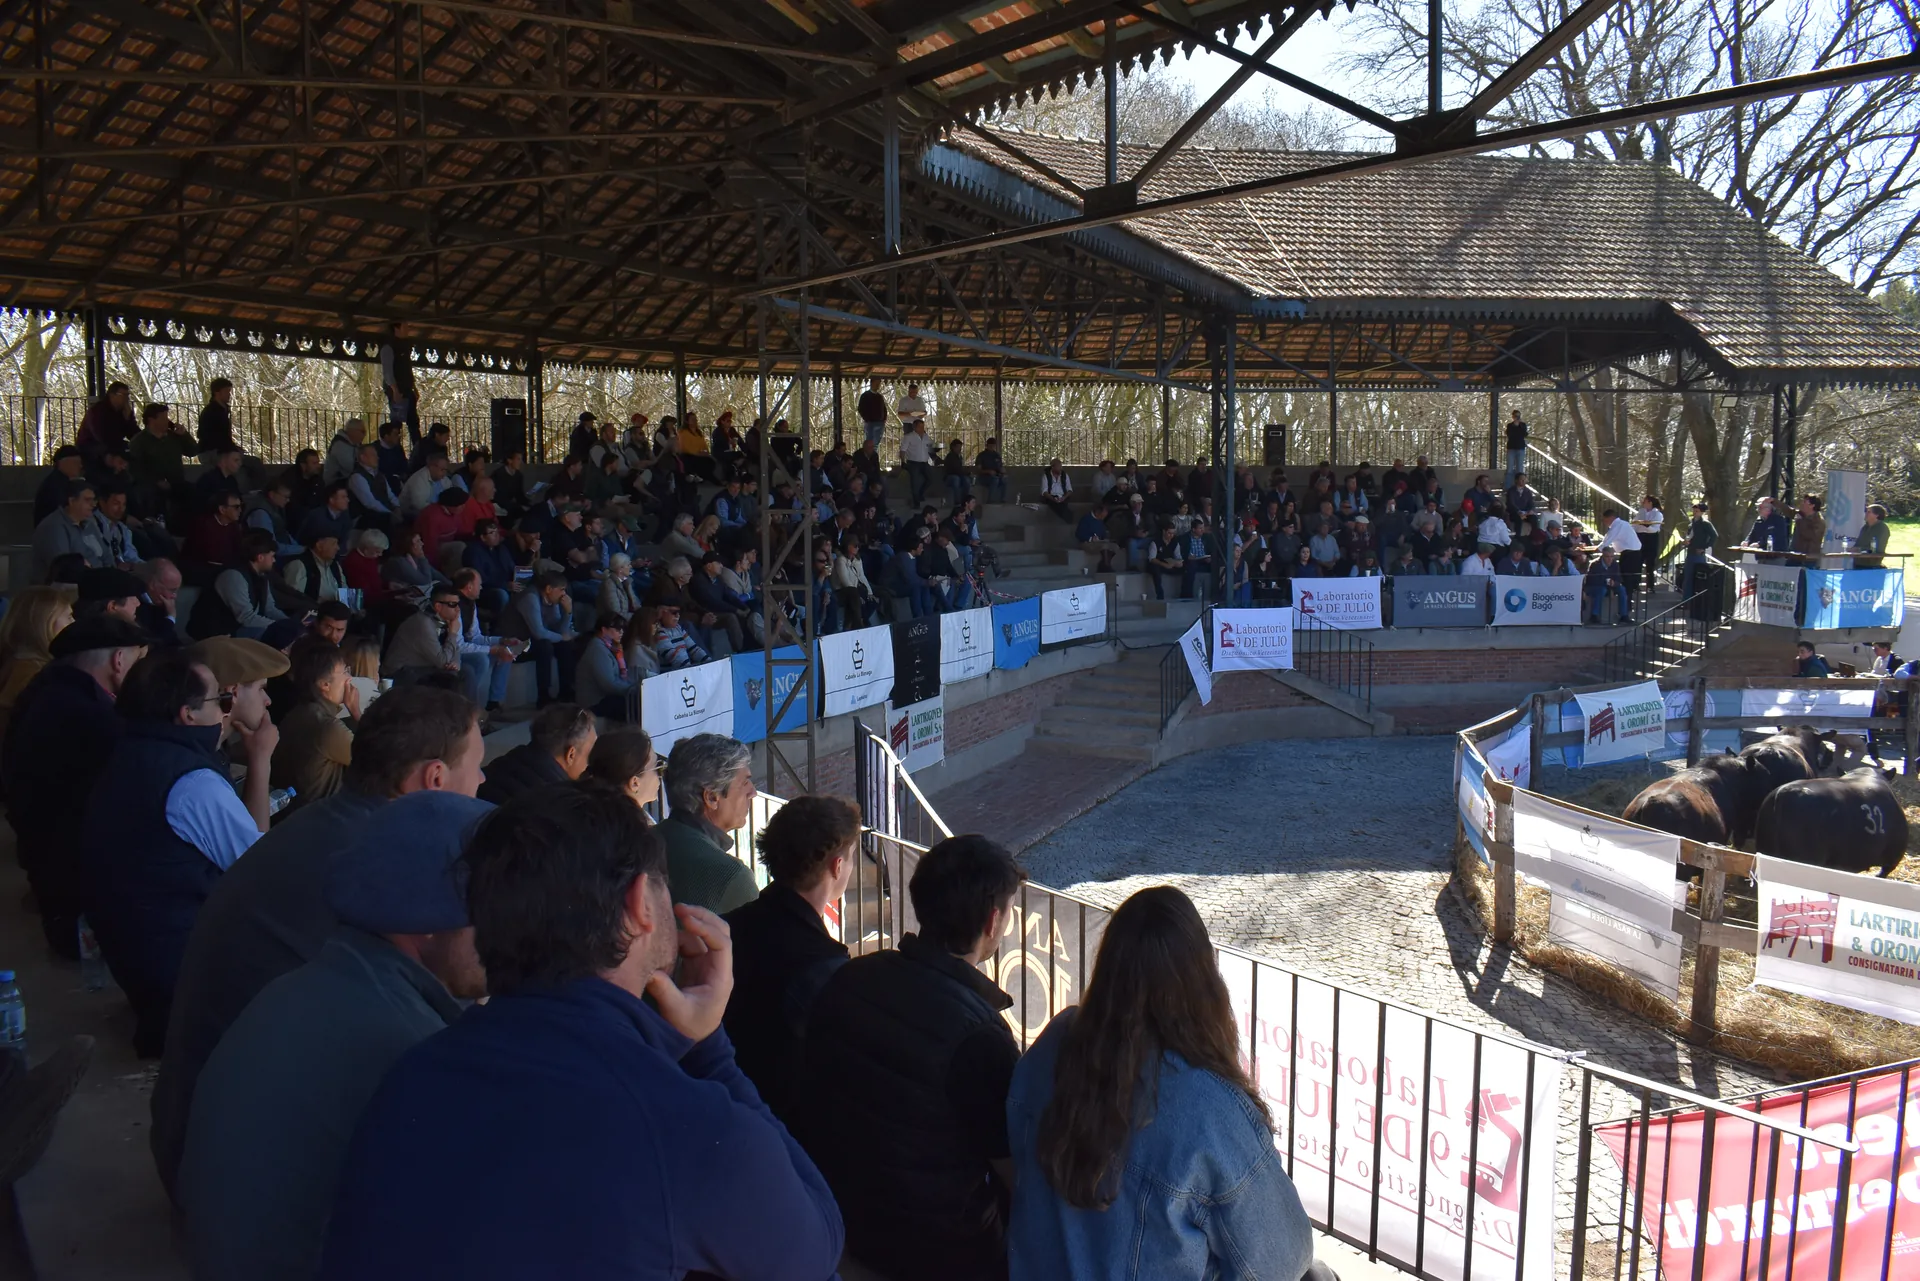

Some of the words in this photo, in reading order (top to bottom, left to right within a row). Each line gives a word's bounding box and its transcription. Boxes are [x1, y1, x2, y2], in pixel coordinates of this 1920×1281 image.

[1316, 589, 1374, 602] Laboratorio
[1423, 590, 1476, 604] ANGUS
[1532, 592, 1575, 603] Biogénesis
[1316, 603, 1323, 613] 9
[1326, 603, 1341, 614] DE
[1343, 602, 1375, 613] JULIO
[1531, 601, 1553, 612] Bagó
[1014, 619, 1038, 638] ANGUS
[1236, 623, 1287, 635] Laboratorio
[1235, 637, 1241, 648] 9
[1243, 636, 1258, 648] DE
[1260, 635, 1288, 648] JULIO
[1617, 700, 1663, 717] LARTIRIGOYEN
[1626, 712, 1649, 728] OROMÍ
[1850, 909, 1920, 940] LARTIRI
[1851, 936, 1863, 952] &
[1848, 955, 1914, 979] CONSIGNATARIA
